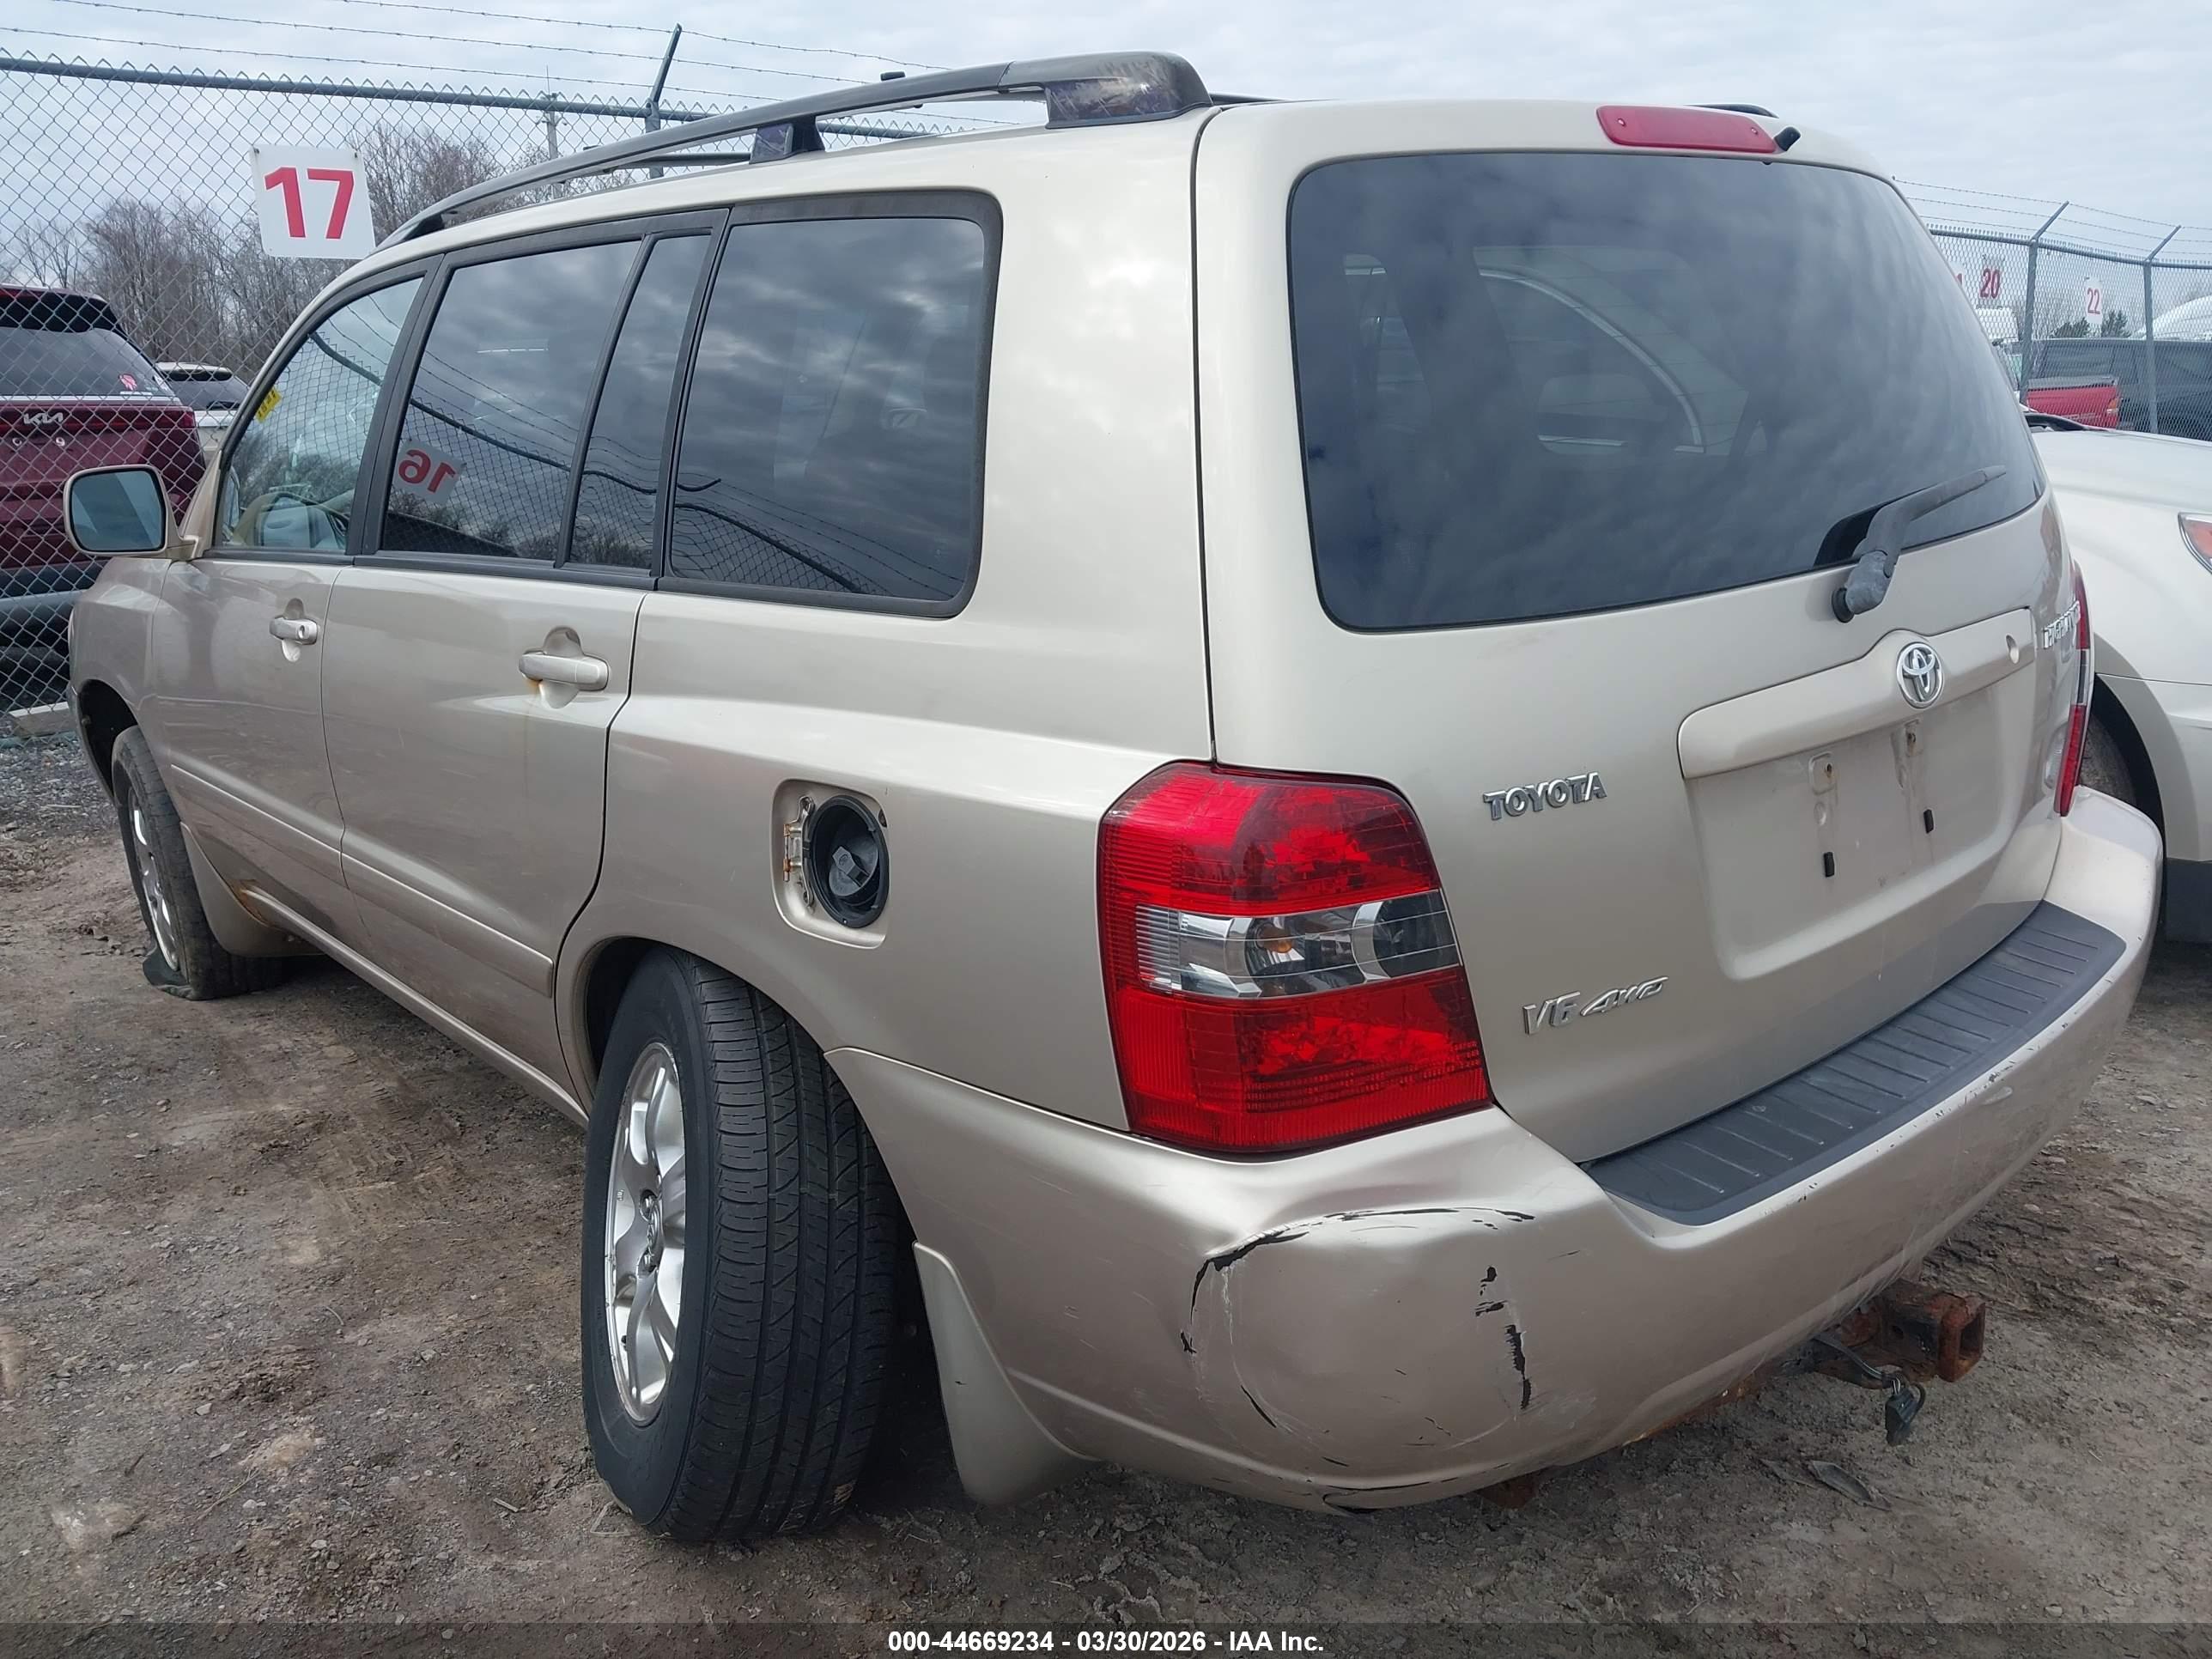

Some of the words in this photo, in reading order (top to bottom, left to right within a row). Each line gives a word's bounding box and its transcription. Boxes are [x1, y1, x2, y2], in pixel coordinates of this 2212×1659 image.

[264, 167, 355, 240] 17
[1979, 267, 2001, 299] 20
[2087, 288, 2100, 315] 22
[23, 411, 64, 425] KIA
[1482, 771, 1607, 821] TOYOTA
[1522, 991, 1581, 1036] V6
[1580, 975, 1668, 1017] 4WD
